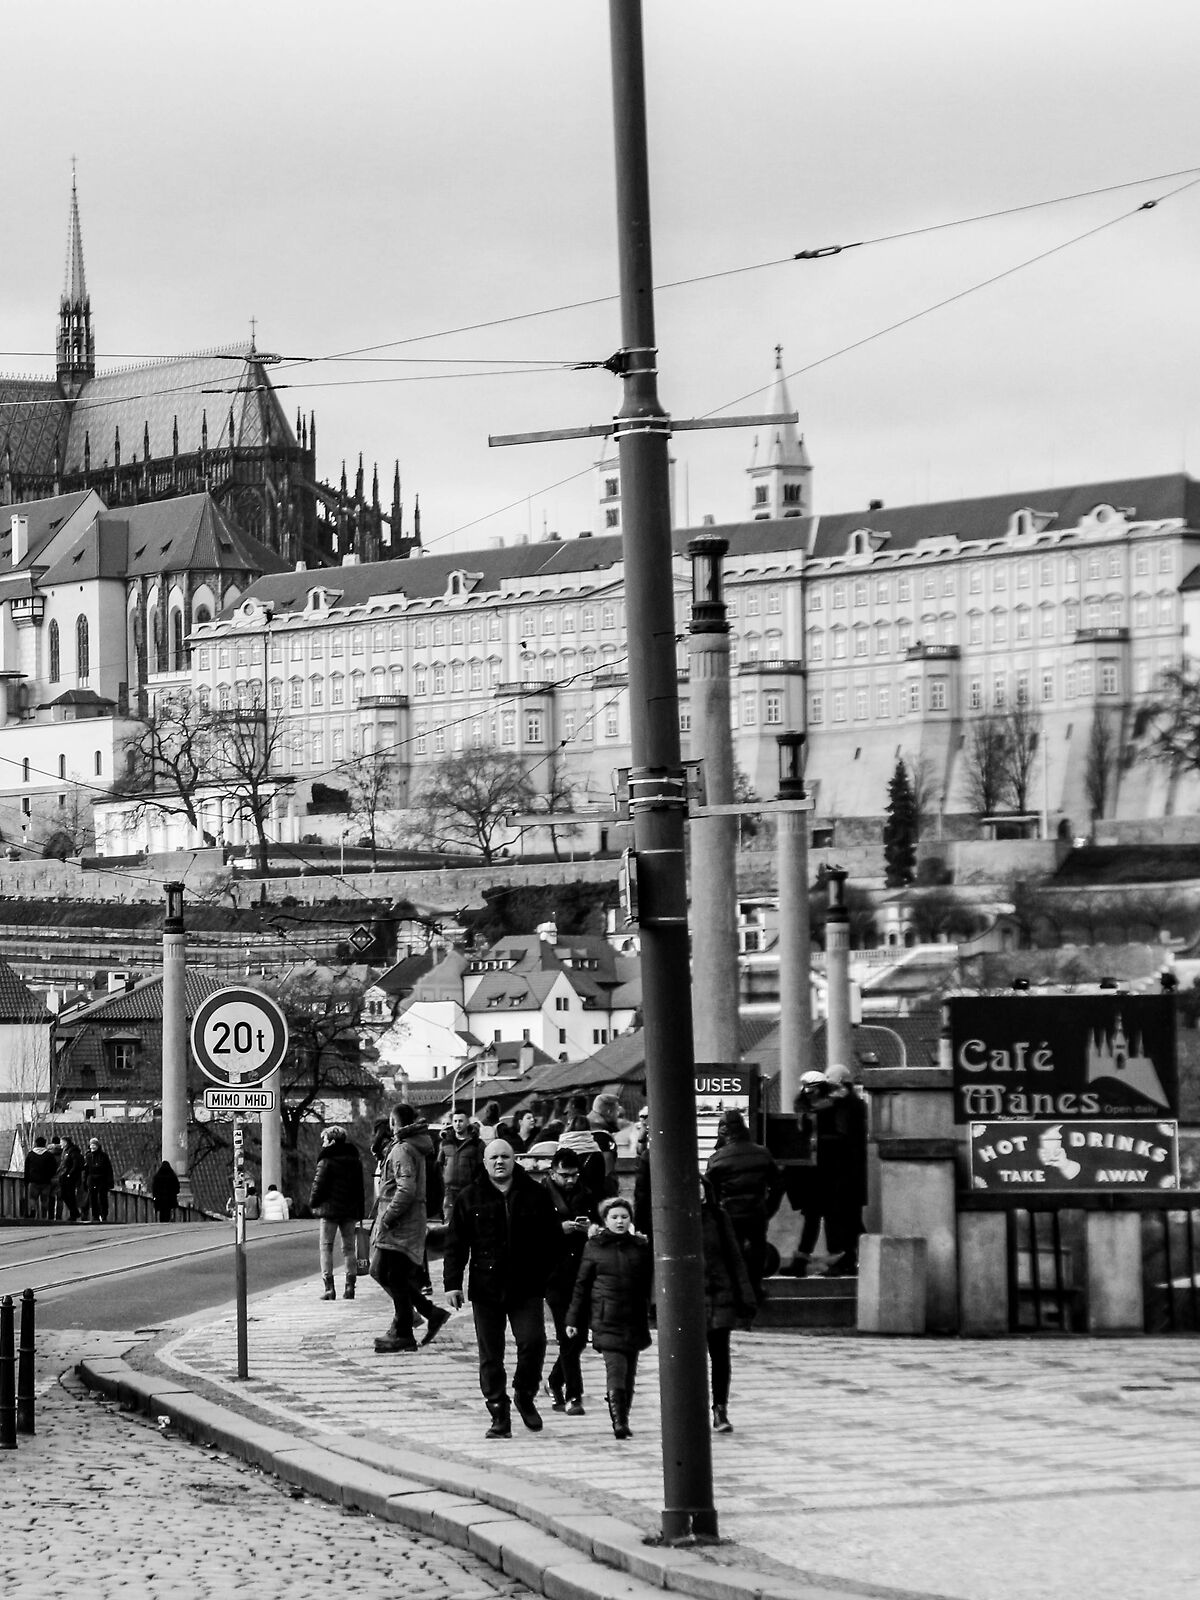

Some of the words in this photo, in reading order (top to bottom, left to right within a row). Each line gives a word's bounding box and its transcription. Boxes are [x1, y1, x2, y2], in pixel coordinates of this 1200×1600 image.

[960, 1039, 1055, 1072] Café
[694, 1078, 742, 1092] UISES
[212, 1094, 240, 1107] MIMO
[244, 1094, 267, 1107] MHD
[961, 1085, 1100, 1115] Mánes
[1104, 1104, 1132, 1115] Open
[1134, 1103, 1158, 1116] daily
[978, 1136, 1028, 1163] HOT
[1069, 1131, 1169, 1163] DRINKS
[999, 1169, 1046, 1183] TAKE
[1095, 1169, 1149, 1183] AWAY
